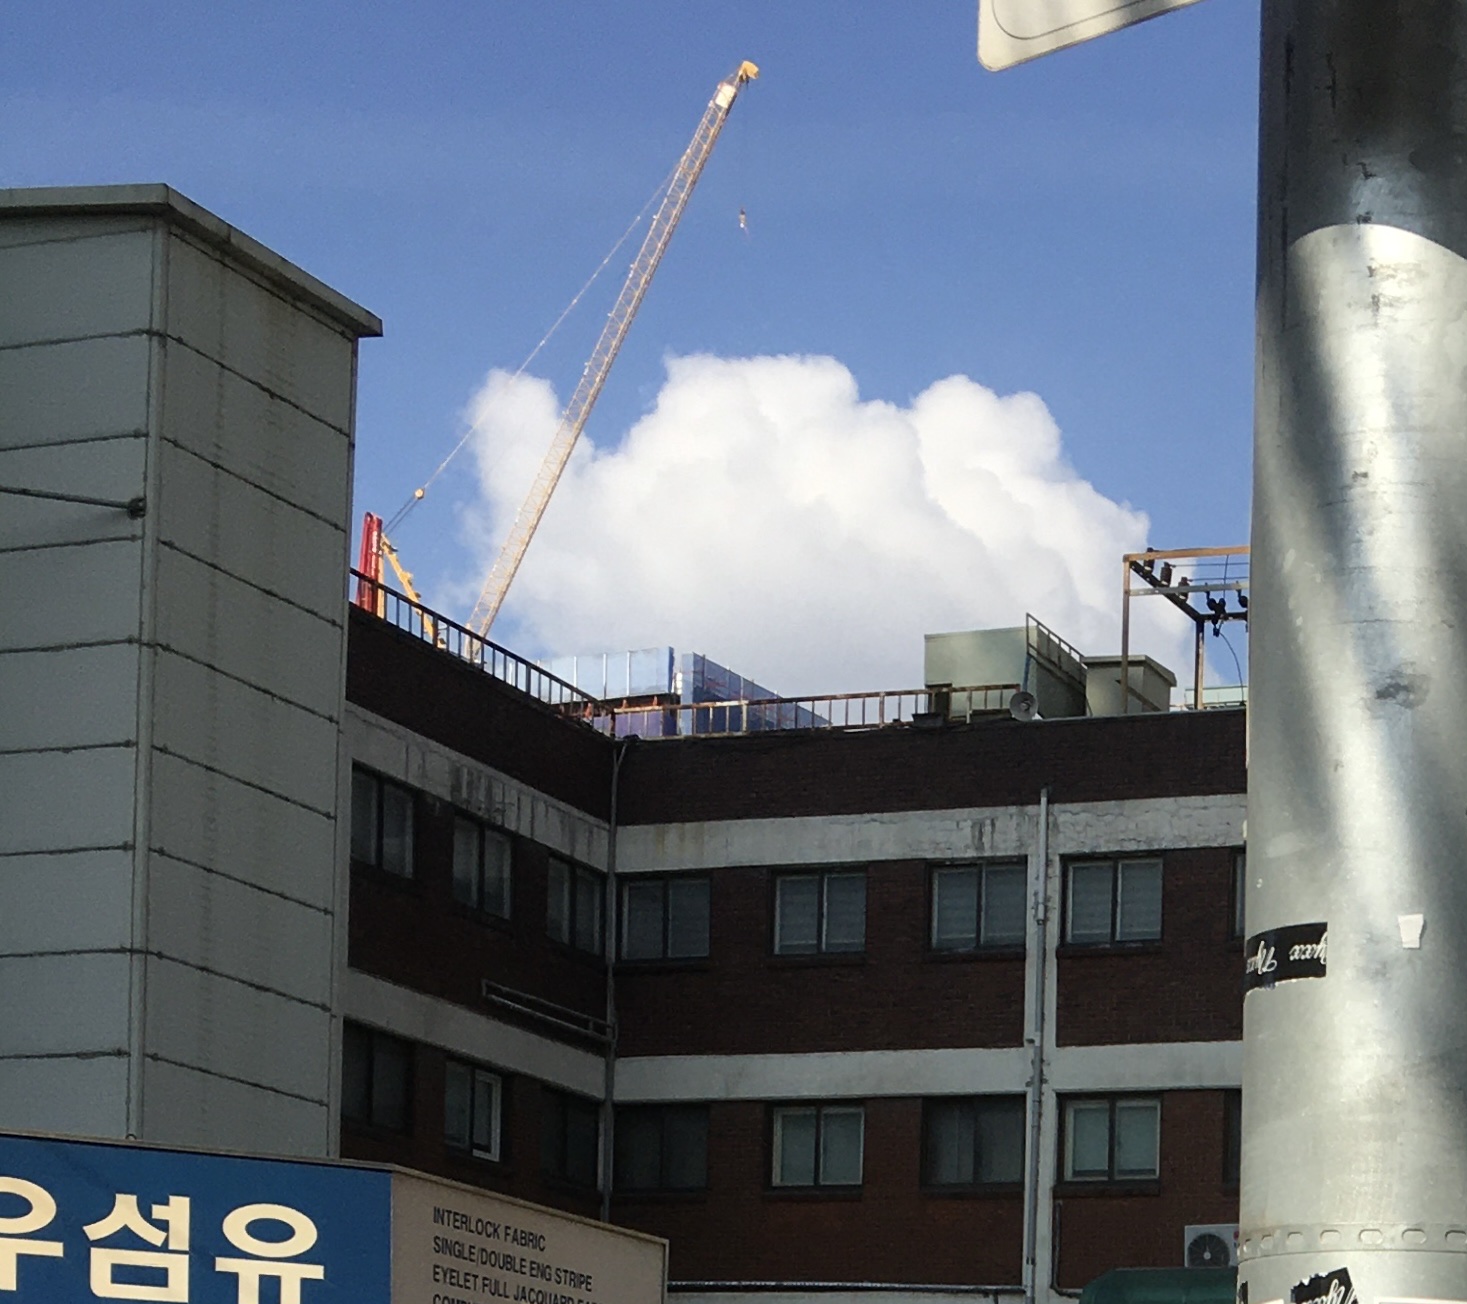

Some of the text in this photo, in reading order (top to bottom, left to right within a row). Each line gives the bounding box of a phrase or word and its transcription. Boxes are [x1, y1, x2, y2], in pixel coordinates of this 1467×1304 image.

[433, 1206, 546, 1252] INTERLOCK FABRIC
[433, 1235, 593, 1292] SINGLE/DOUBLE ENG STRIPE
[433, 1264, 479, 1292] EYELET
[482, 1276, 510, 1300] FULL
